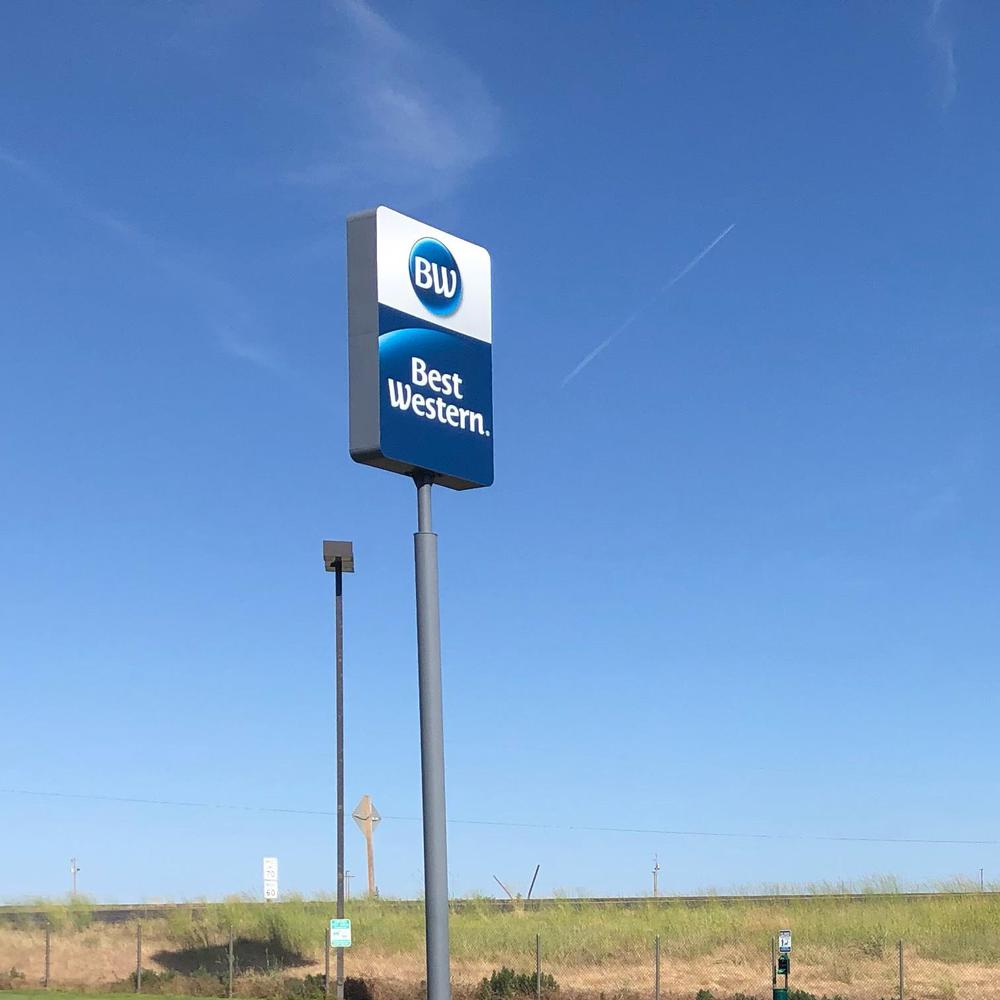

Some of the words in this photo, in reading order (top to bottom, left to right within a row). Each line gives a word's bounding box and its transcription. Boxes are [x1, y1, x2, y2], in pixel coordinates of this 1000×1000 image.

[414, 256, 457, 299] BW
[411, 356, 463, 400] Best
[387, 378, 491, 437] Western.
